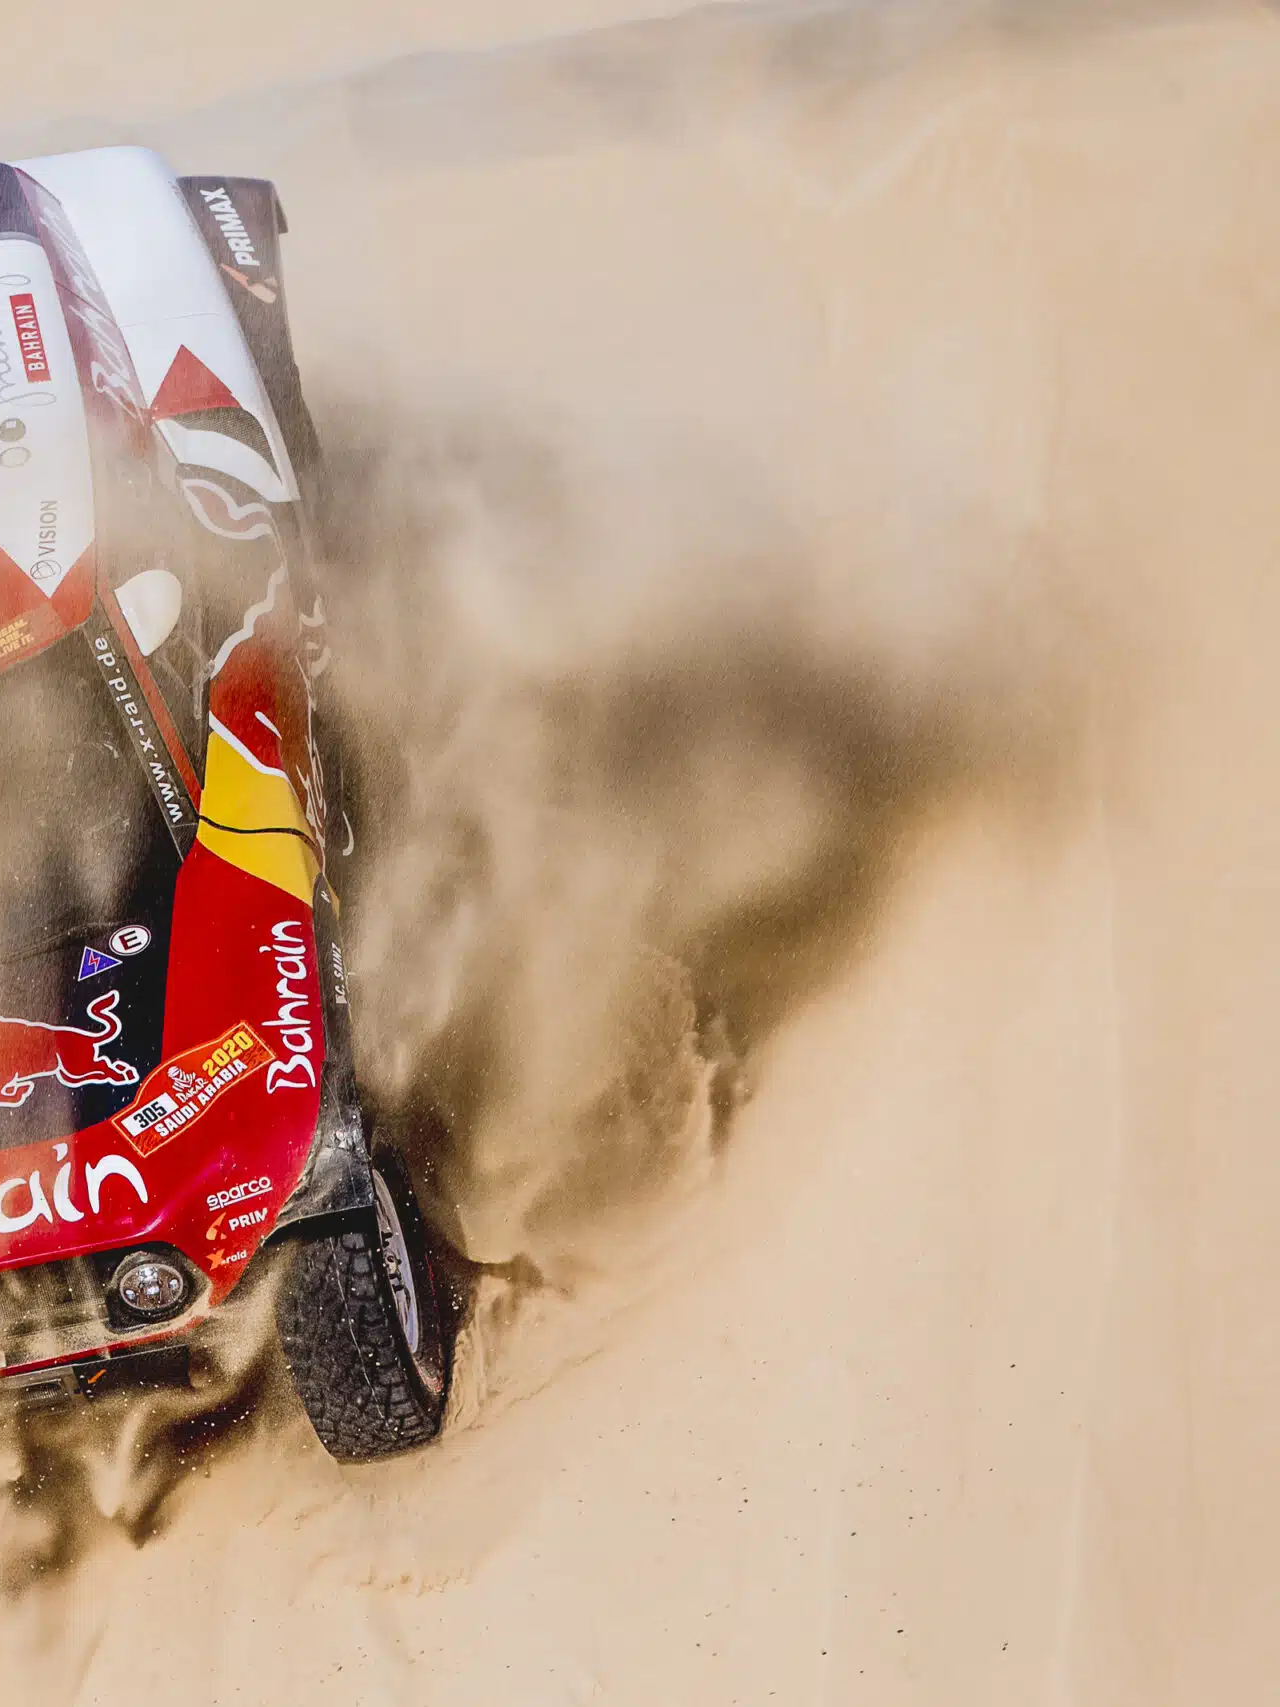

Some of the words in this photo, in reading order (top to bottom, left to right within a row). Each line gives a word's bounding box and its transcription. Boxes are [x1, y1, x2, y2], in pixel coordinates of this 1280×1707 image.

[200, 187, 260, 266] PRIMAX
[15, 304, 46, 372] BAHRAIN
[38, 500, 58, 557] VISION
[94, 636, 184, 824] www.x-raid.de
[259, 920, 317, 1095] Bahrain
[202, 1030, 254, 1077] 2020
[133, 1101, 167, 1129] 305
[154, 1101, 200, 1137] SAUDI
[197, 1058, 248, 1106] ARABIA
[206, 1176, 273, 1212] sparco
